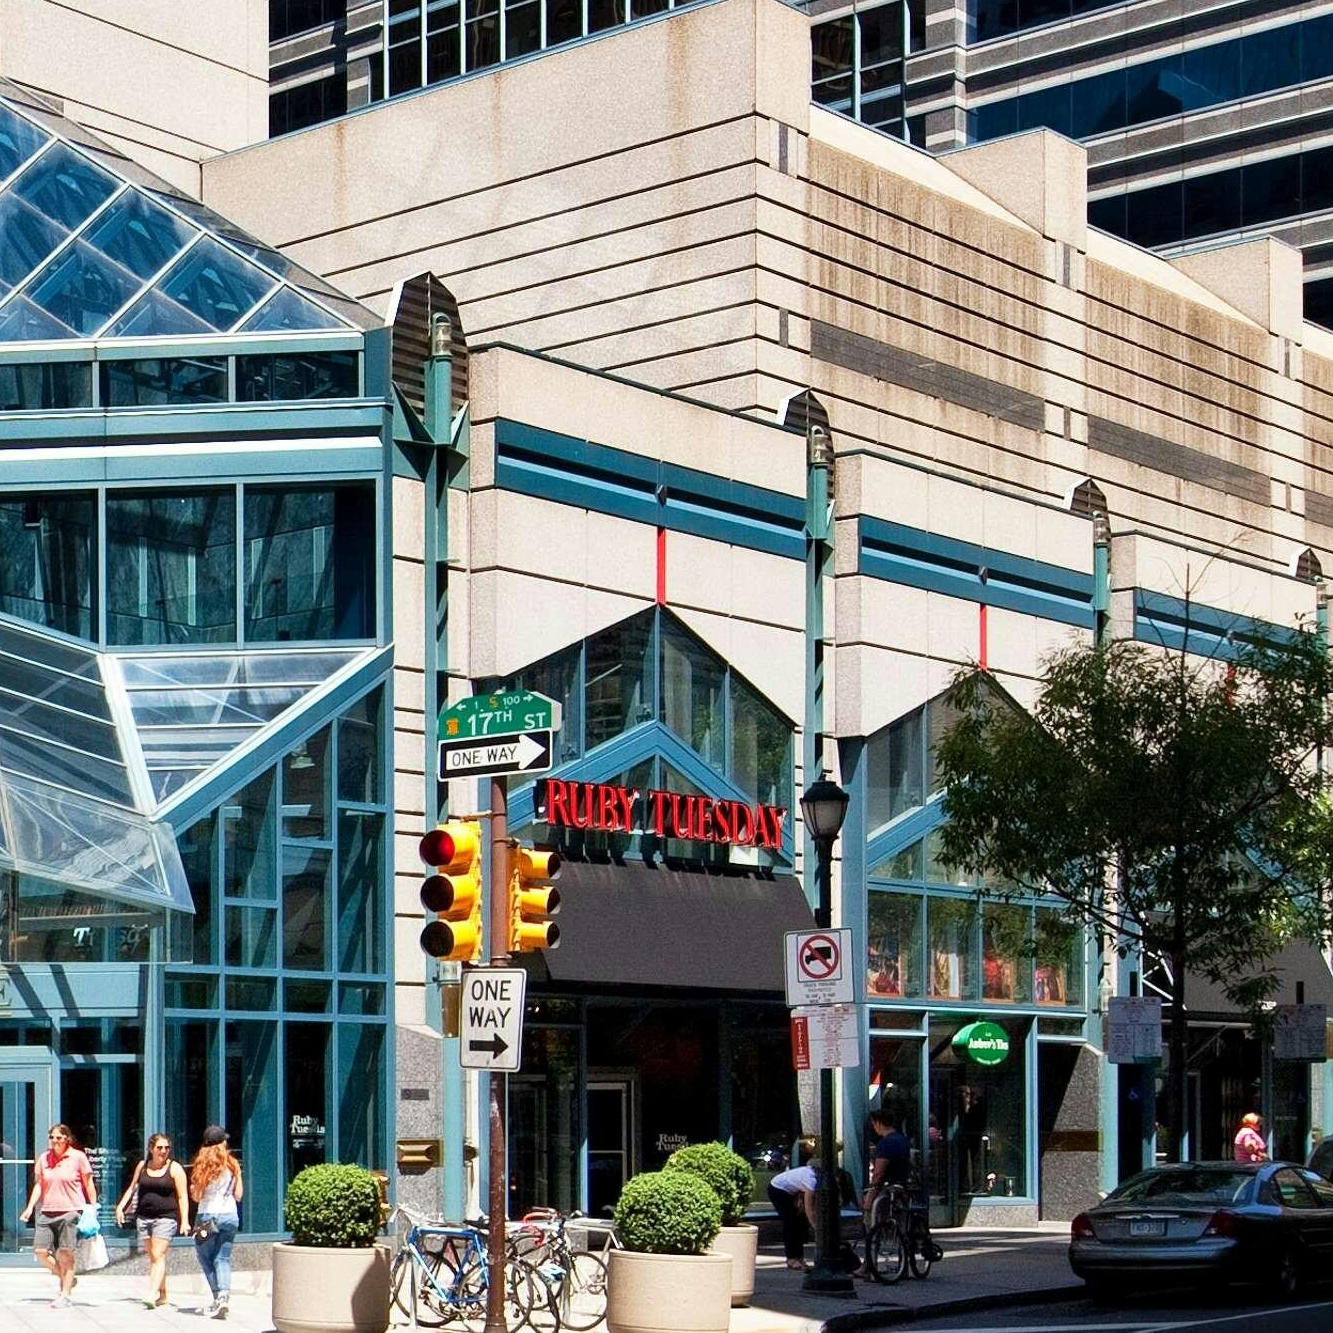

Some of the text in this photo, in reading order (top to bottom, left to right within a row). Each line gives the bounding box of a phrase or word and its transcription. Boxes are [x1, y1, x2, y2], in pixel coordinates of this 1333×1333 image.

[502, 695, 520, 706] 100
[467, 709, 547, 736] 17TH ST
[452, 745, 517, 767] ONE WAY
[546, 777, 787, 850] RUBY TUESDAY
[471, 979, 512, 1002] ONE
[469, 1006, 512, 1028] WAY
[292, 1114, 319, 1127] Ruby
